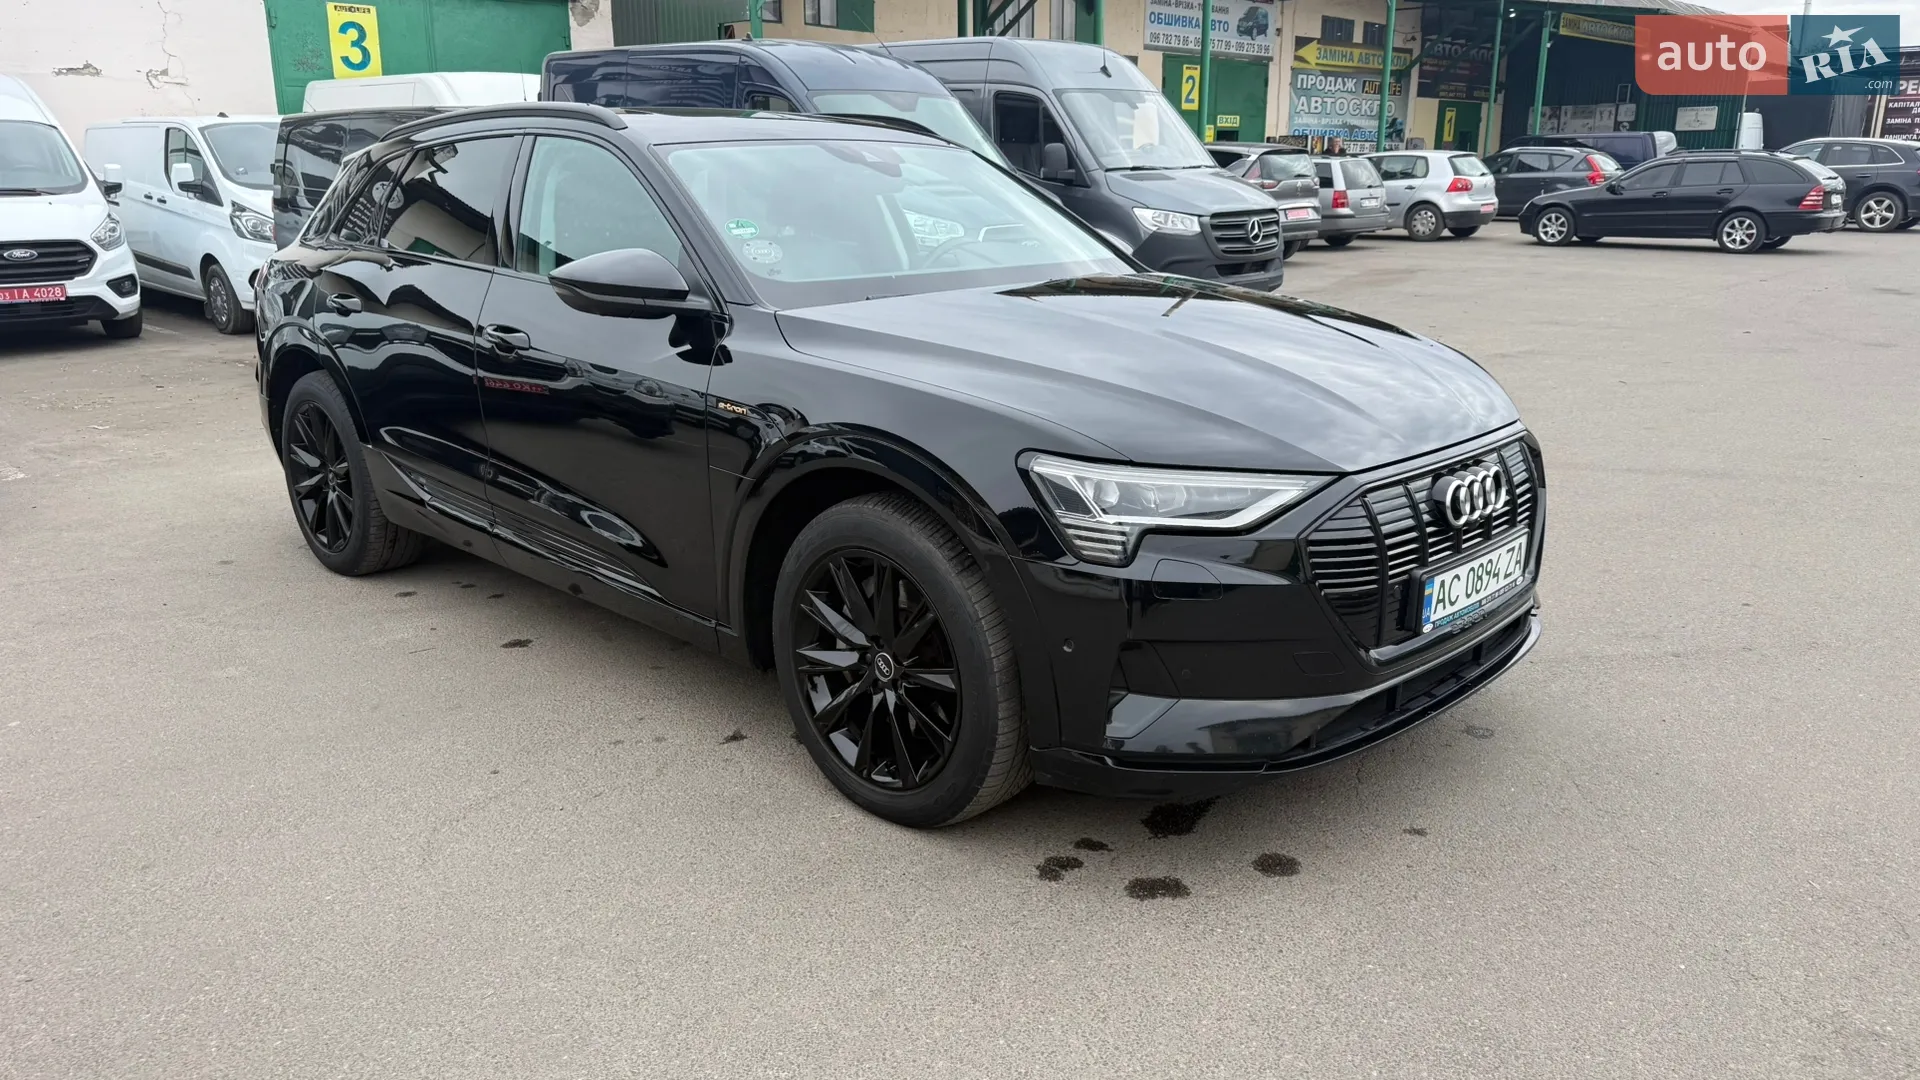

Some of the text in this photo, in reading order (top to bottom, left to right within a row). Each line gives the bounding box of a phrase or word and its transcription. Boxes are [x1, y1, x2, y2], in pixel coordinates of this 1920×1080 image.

[1149, 11, 1230, 33] ОБШИВКА ВТО
[338, 21, 371, 71] 3
[1150, 32, 1161, 43] 096
[1162, 34, 1173, 44] 782
[1316, 47, 1355, 63] ЗАМІНА
[1184, 75, 1196, 103] 2
[1297, 74, 1356, 93] ПРОДАЖ
[1218, 116, 1238, 125] ВХІД
[1447, 115, 1453, 138] 1
[33, 287, 62, 298] 4028
[718, 402, 747, 415] e-tron
[1433, 574, 1461, 614] AC
[1465, 553, 1502, 599] 0894
[1503, 542, 1522, 580] ZA
